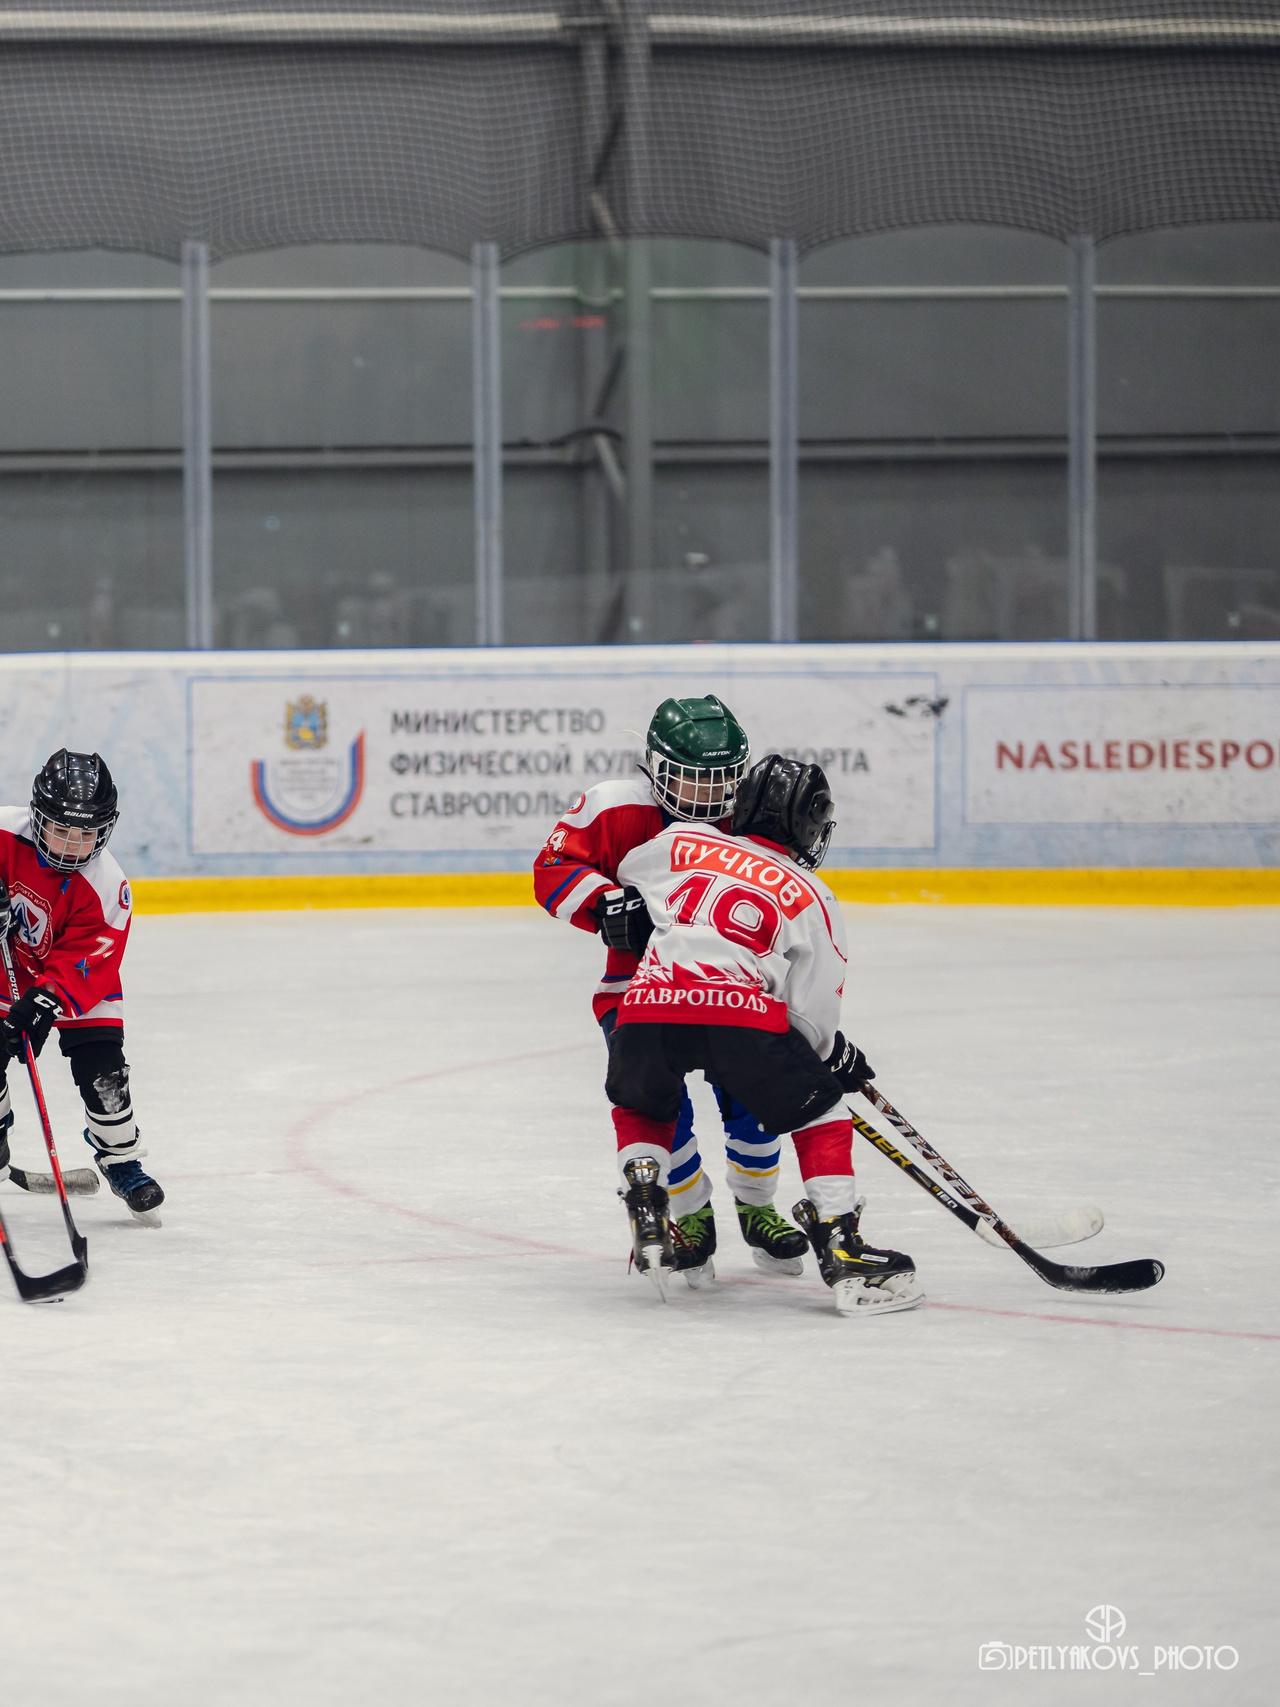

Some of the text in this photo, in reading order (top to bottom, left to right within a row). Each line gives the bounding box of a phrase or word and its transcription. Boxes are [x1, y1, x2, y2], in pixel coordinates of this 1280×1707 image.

[390, 708, 606, 735] МИНИСТЕРСТВО
[390, 744, 572, 776] ФИЗИЧЕСКОЙ
[995, 740, 1280, 771] NASLEDIESPO
[63, 810, 94, 819] BAUER
[674, 840, 803, 907] ПУЧКОВ
[665, 872, 783, 958] 19
[623, 987, 768, 1014] СТАВРОПОЛЬ
